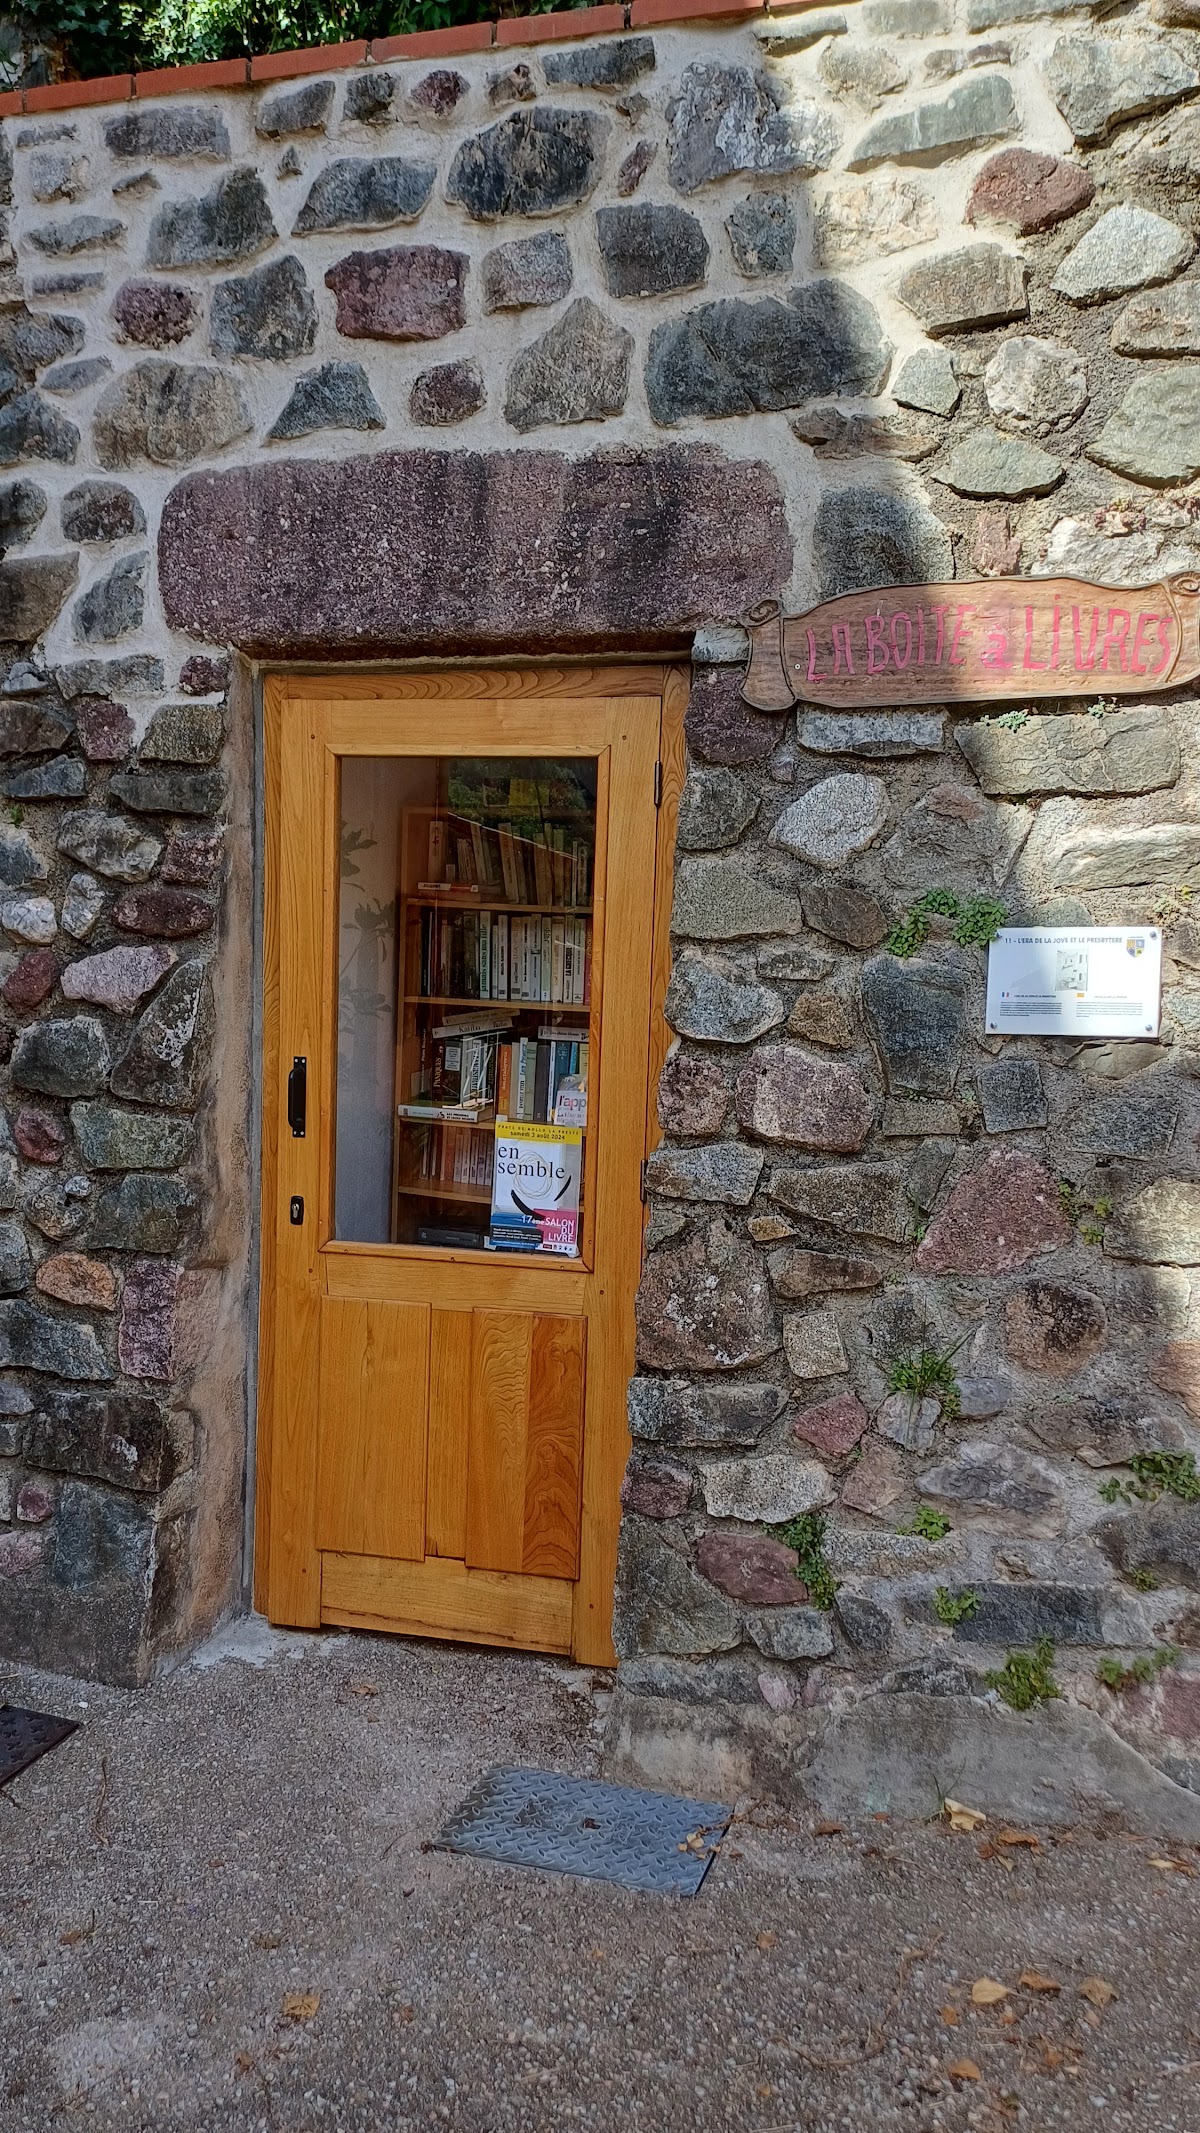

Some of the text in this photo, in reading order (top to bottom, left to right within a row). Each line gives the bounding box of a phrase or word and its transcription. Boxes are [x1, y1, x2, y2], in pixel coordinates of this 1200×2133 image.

[806, 622, 856, 681] LA
[864, 604, 977, 675] BOITE
[498, 1145, 519, 1160] en
[497, 1160, 565, 1179] semble
[545, 1217, 575, 1228] SALON
[561, 1225, 574, 1235] DU
[548, 1233, 574, 1243] LIVRE
